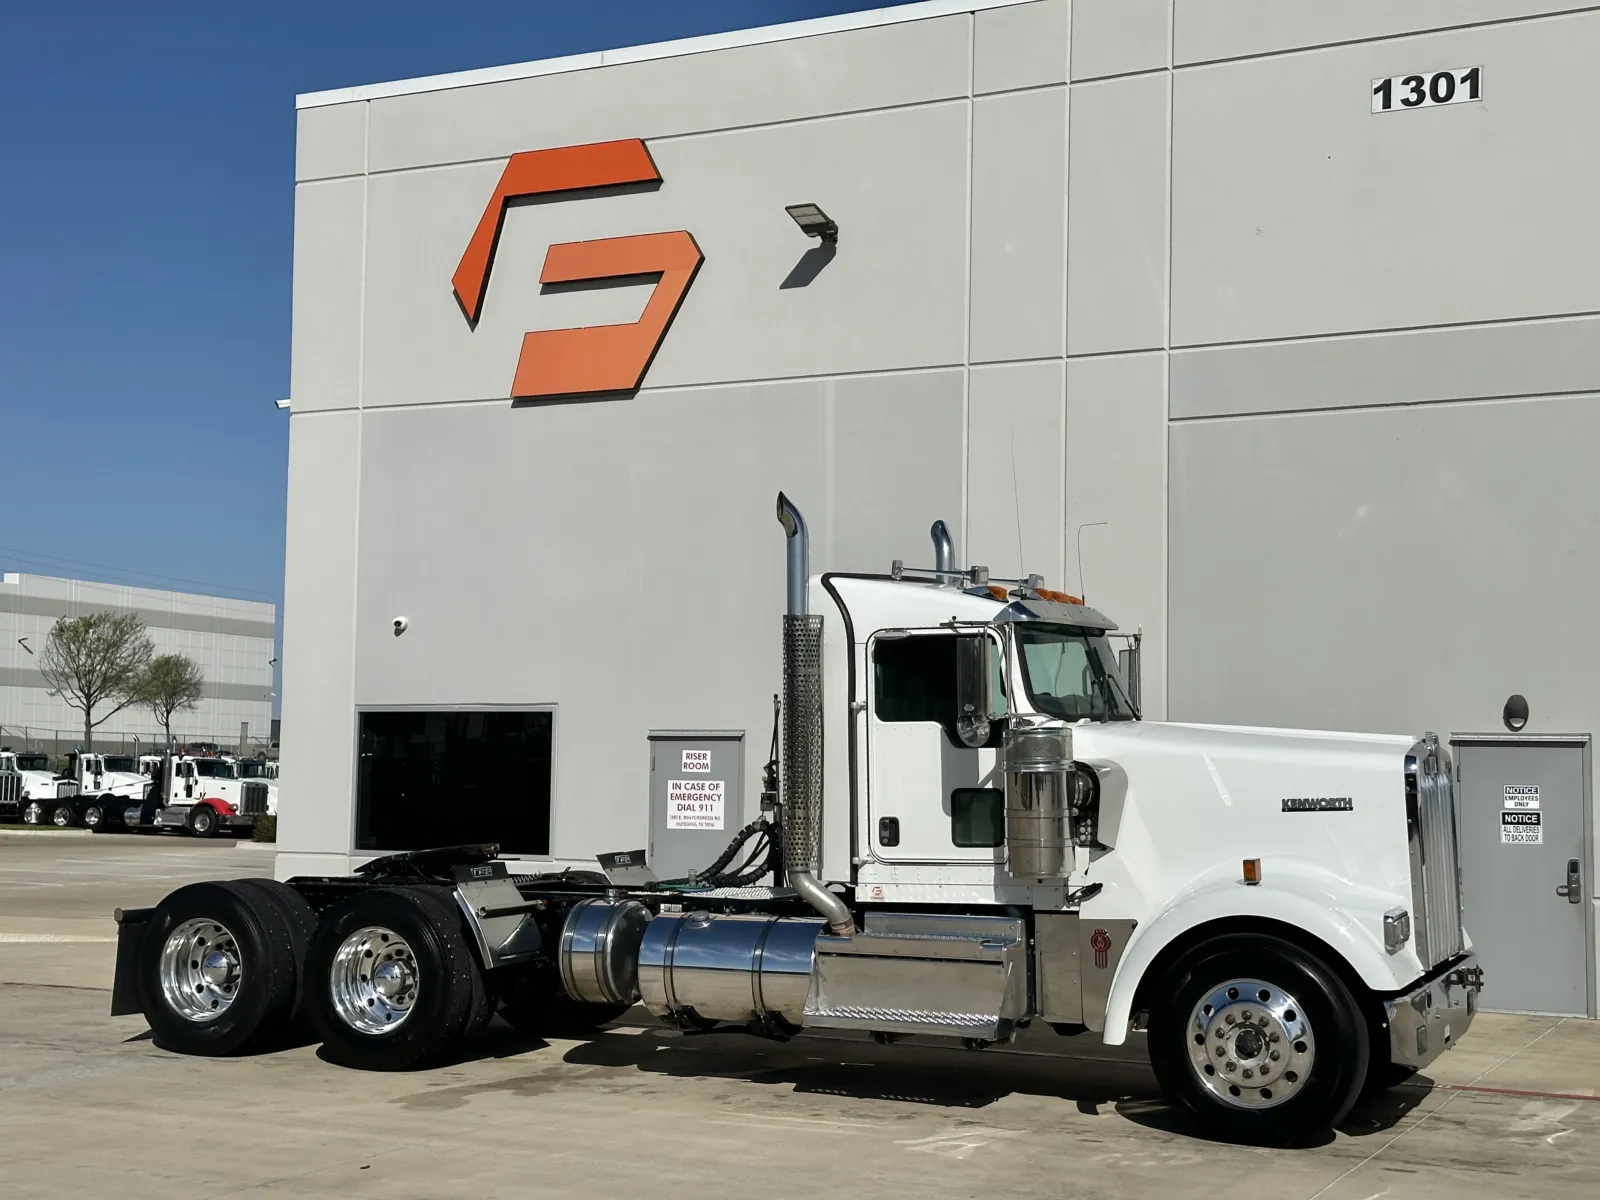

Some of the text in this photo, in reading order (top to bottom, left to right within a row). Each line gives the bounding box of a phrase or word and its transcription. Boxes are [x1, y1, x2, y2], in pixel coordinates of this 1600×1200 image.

[1373, 67, 1480, 110] 1301
[685, 752, 707, 760] RISER
[683, 762, 709, 770] ROOM
[672, 782, 721, 791] IN CASE OF
[670, 793, 722, 801] EMERGENCY
[677, 803, 713, 812] DIAL 911
[1281, 797, 1353, 810] KENWORTH
[1504, 814, 1538, 823] NOTICE
[1503, 825, 1539, 834] ALL DELIVERIES
[1525, 834, 1539, 842] DOOR
